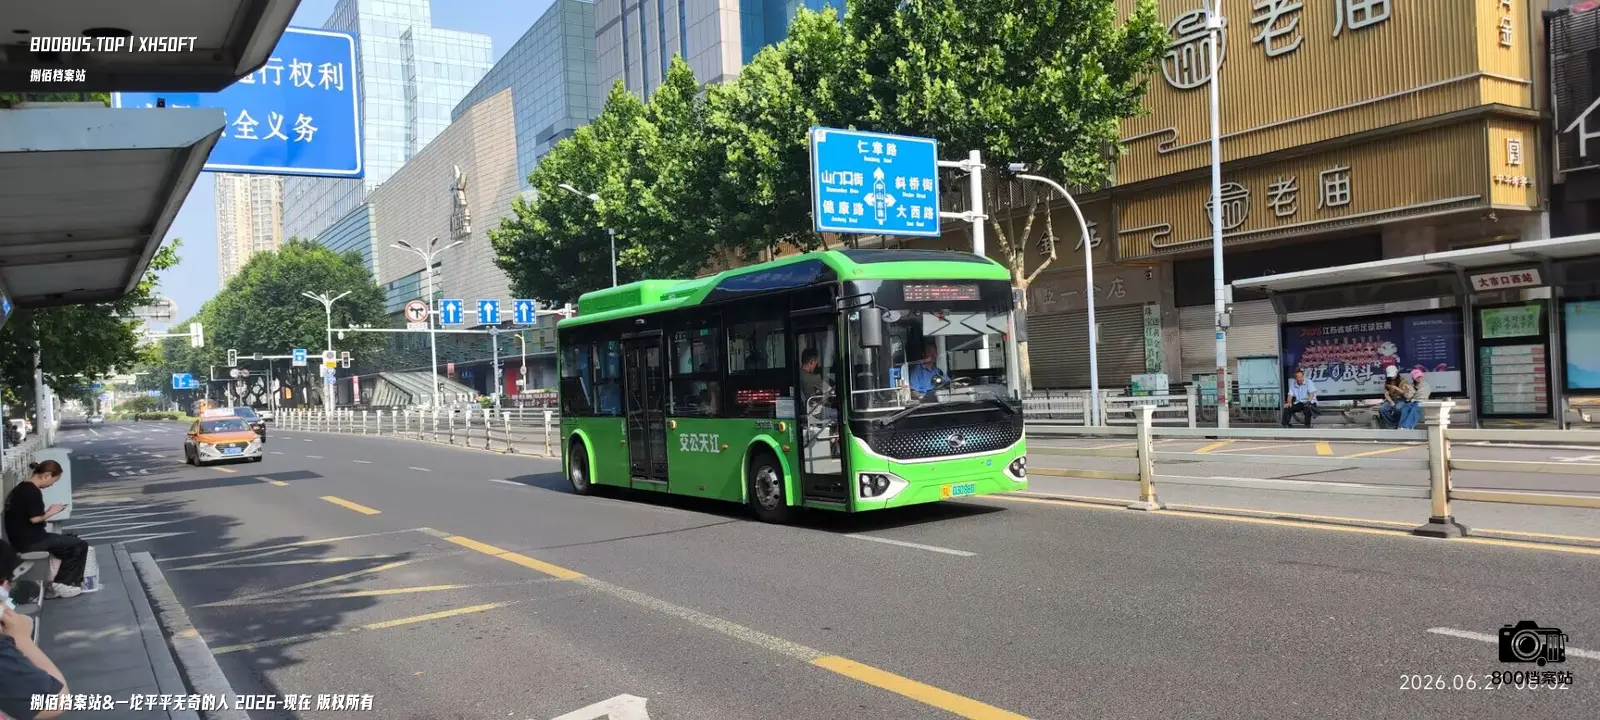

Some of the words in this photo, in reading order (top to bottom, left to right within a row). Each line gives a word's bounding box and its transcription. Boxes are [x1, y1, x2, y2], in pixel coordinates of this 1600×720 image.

[219, 108, 318, 143] 全义务
[857, 140, 897, 156] 仁章路
[821, 170, 864, 186] 山门口街
[895, 176, 933, 192] 斜桥街
[1266, 164, 1352, 217] 老庙
[822, 200, 864, 216] 健康路
[896, 205, 934, 220] 大西路
[1478, 272, 1533, 287] 大市口西站
[1343, 363, 1374, 382] 战斗
